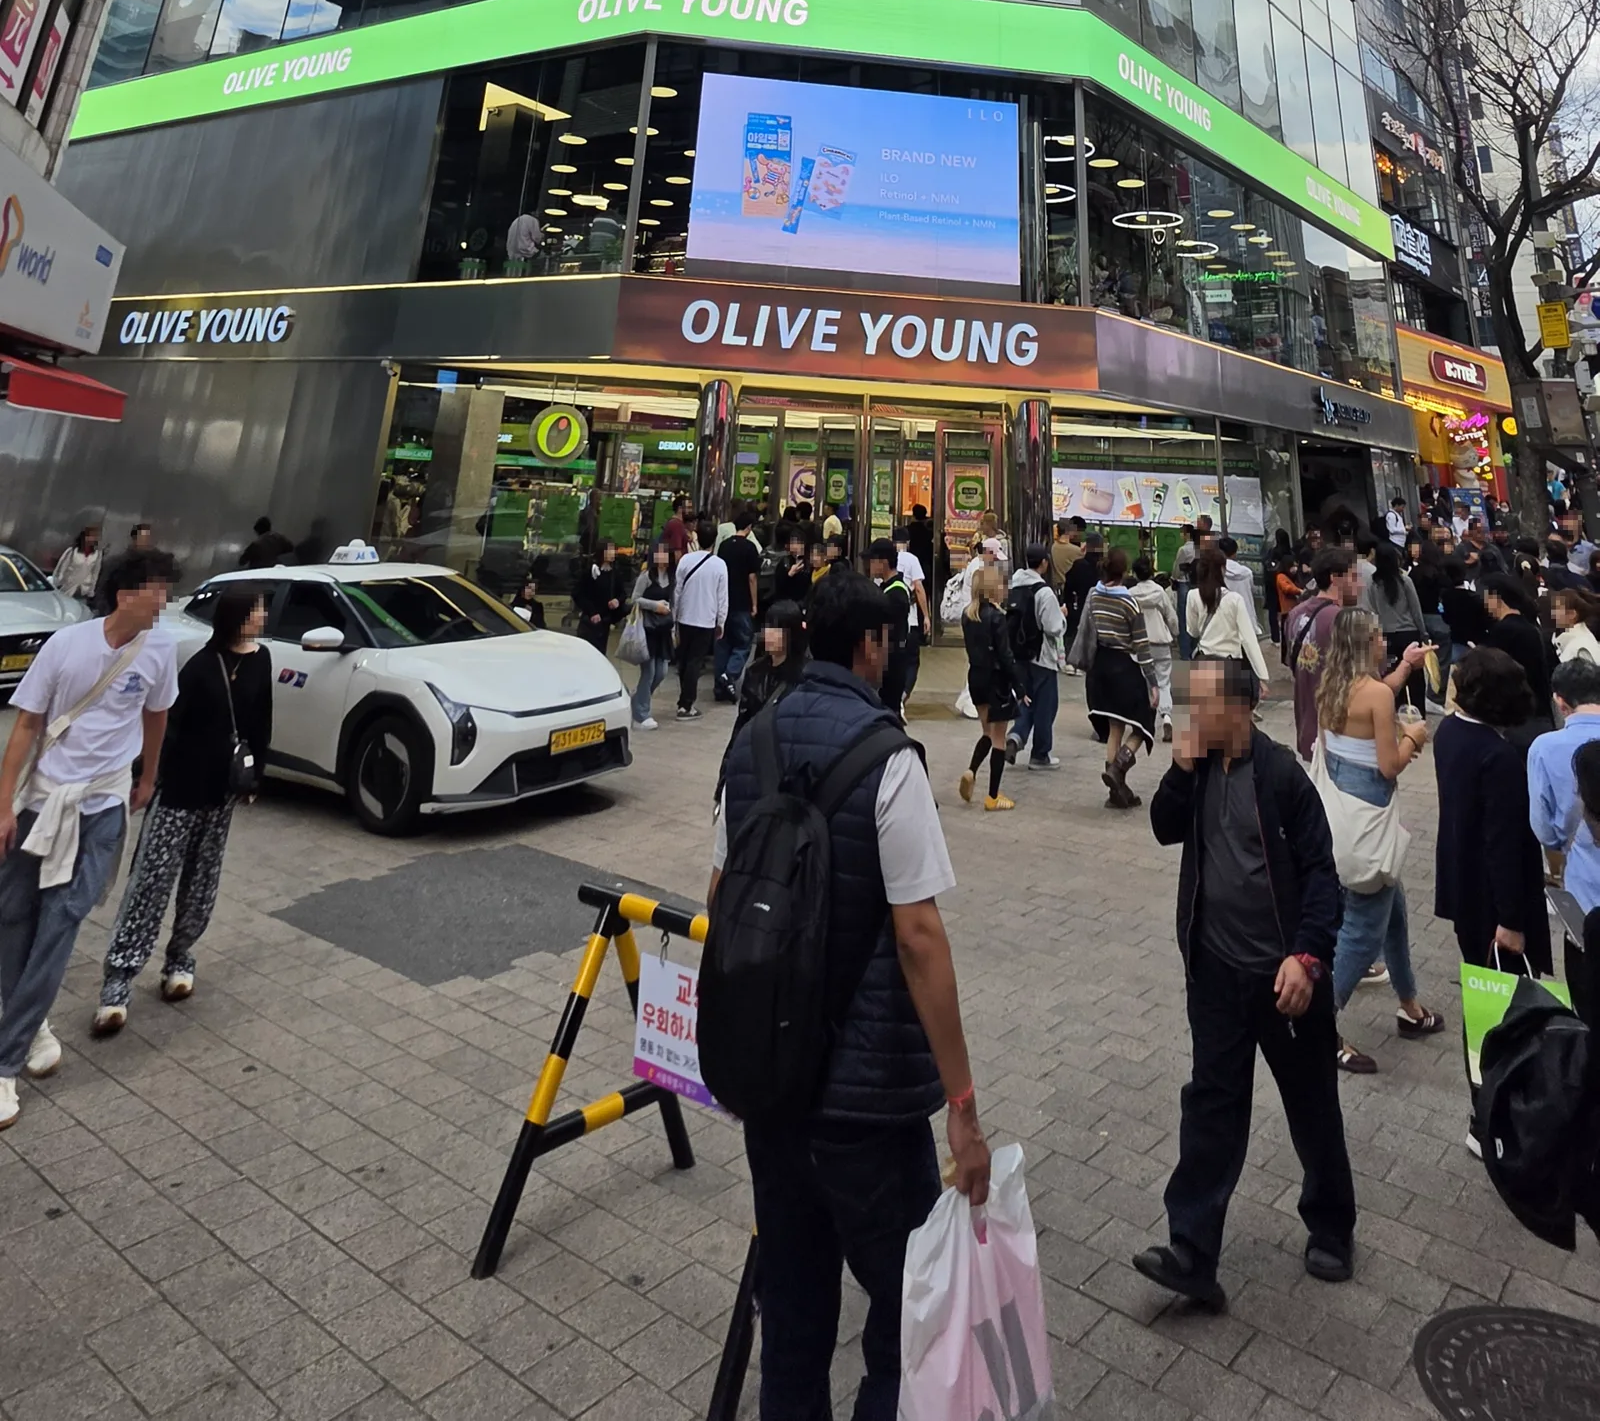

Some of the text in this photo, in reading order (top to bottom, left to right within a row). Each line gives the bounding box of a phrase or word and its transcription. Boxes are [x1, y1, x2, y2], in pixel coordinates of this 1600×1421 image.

[223, 48, 352, 95] OLIVE YOUNG
[1118, 53, 1211, 132] OLIVE YOUNG
[968, 108, 1004, 122] ILO
[881, 148, 977, 168] BRAND NEW
[880, 173, 899, 183] ILO
[880, 188, 917, 201] Retinol
[931, 193, 960, 205] NMN
[879, 211, 930, 223] Plant-Based
[931, 216, 962, 226] Retinol
[972, 219, 996, 229] NMN
[17, 242, 55, 285] world
[120, 309, 193, 345] OLIVE
[195, 306, 291, 343] YOUNG
[681, 299, 1040, 367] OLIVE YOUNG
[676, 973, 699, 1009] 교
[1468, 976, 1510, 996] OLIVE
